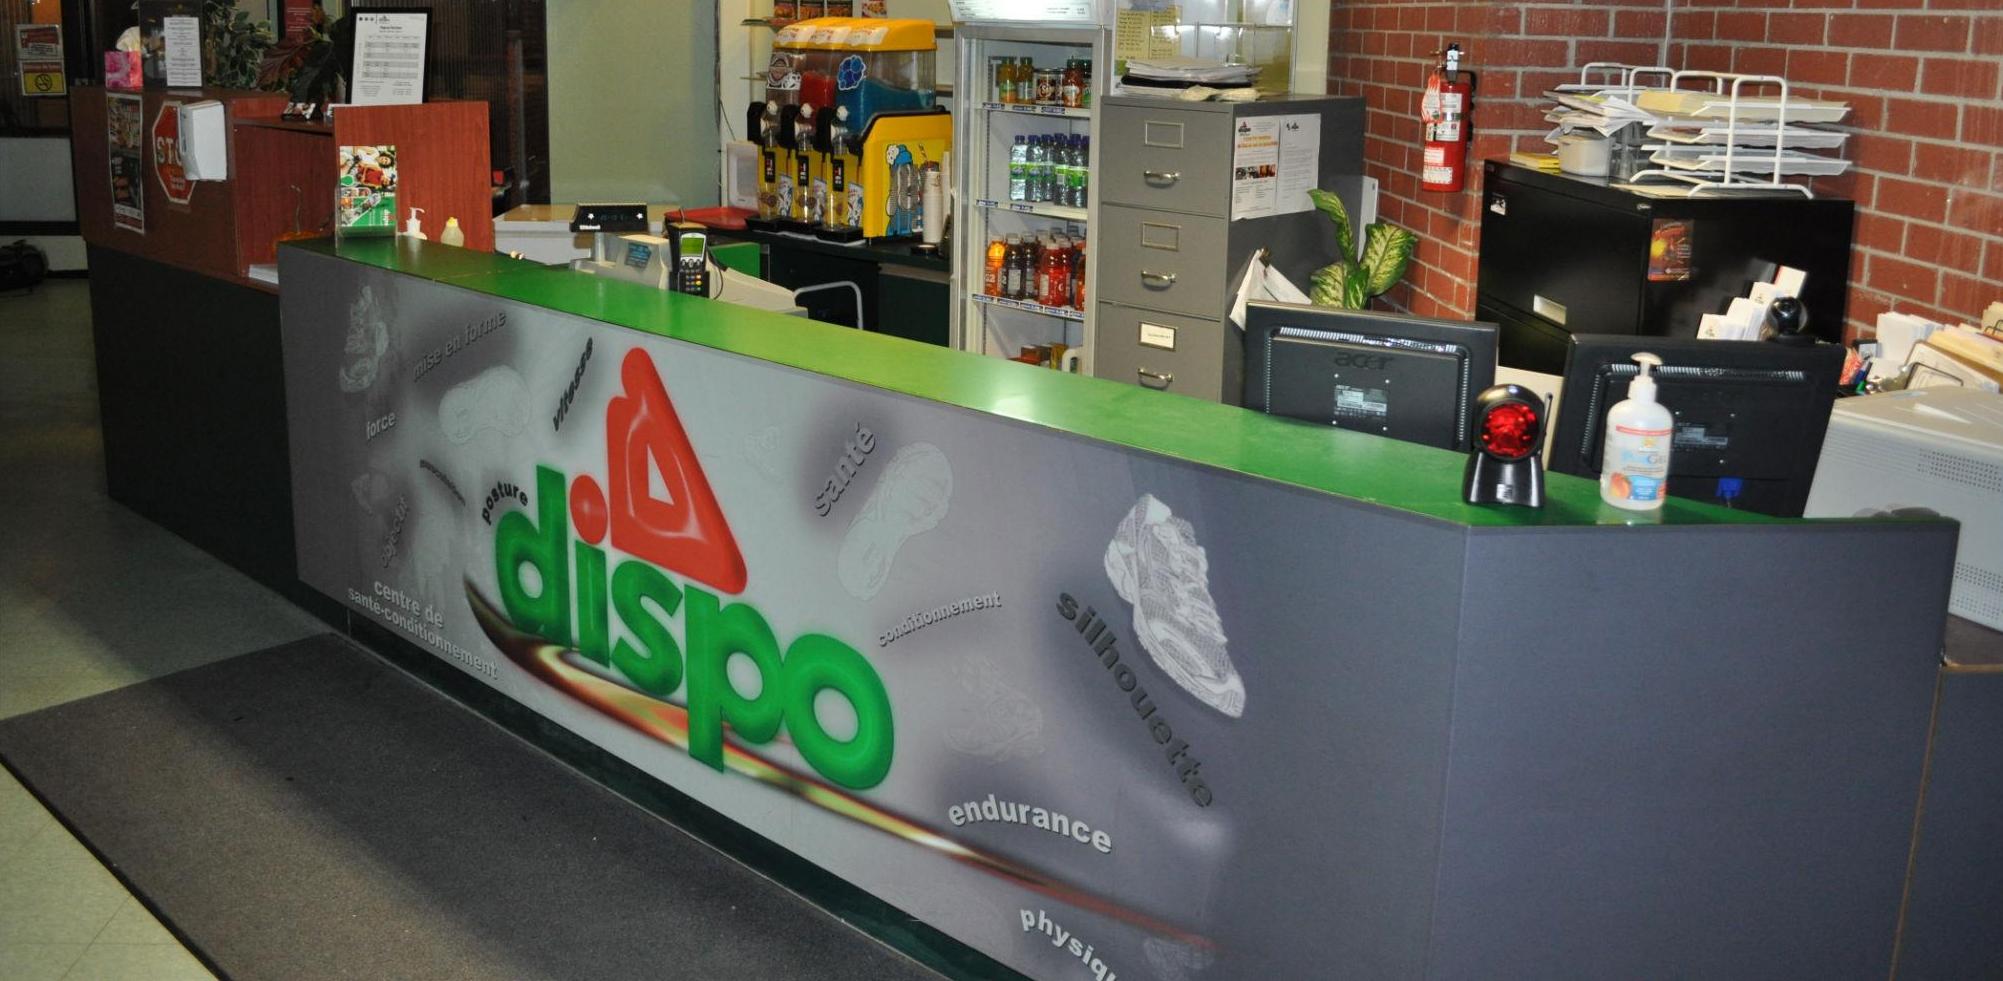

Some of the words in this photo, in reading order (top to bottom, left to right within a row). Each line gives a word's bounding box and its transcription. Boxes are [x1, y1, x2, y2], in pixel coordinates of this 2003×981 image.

[156, 136, 182, 166] STO
[413, 350, 442, 382] mise
[445, 336, 462, 357] en
[464, 310, 507, 346] forme
[1334, 351, 1394, 369] acer
[553, 337, 593, 432] vitesse
[366, 411, 397, 441] force
[815, 422, 876, 517] santé
[482, 481, 528, 526] posture
[348, 588, 498, 680] santé-conditionnement
[374, 581, 421, 618] centre
[425, 605, 444, 628] de
[495, 464, 894, 790] dispo
[878, 591, 1002, 648] conditionnement
[1056, 592, 1213, 807] silhouette
[948, 794, 1113, 854] endurance
